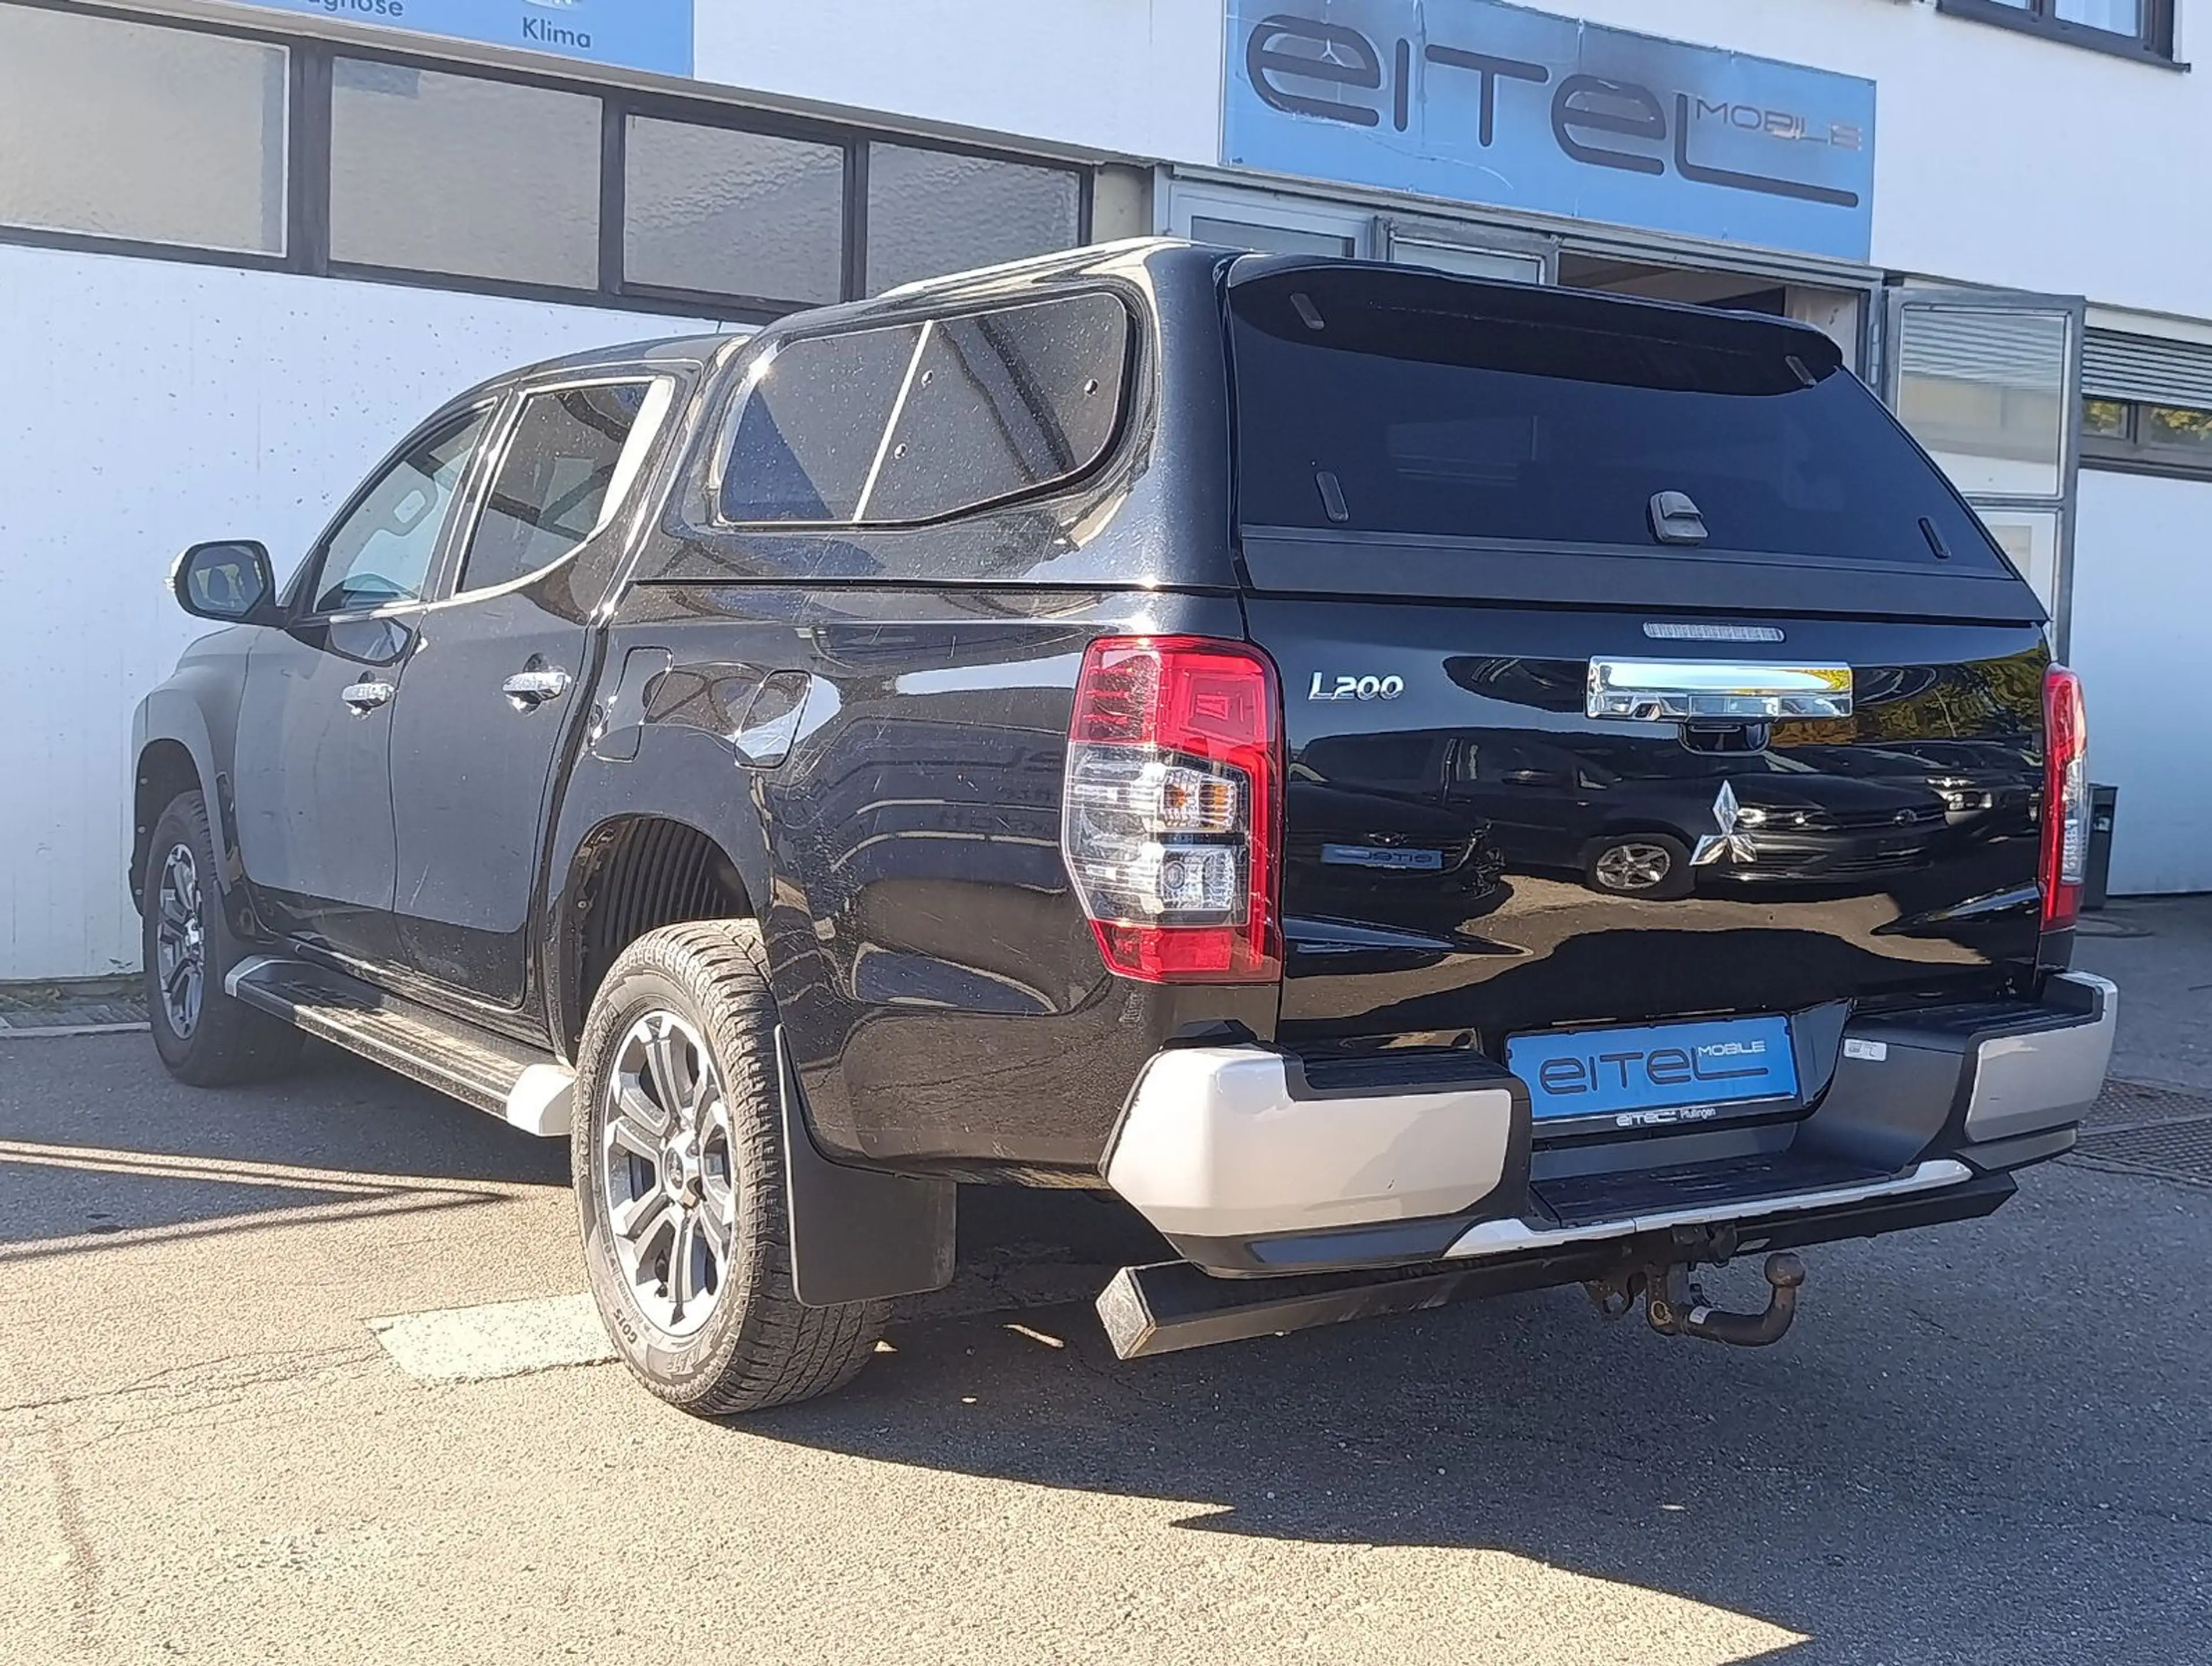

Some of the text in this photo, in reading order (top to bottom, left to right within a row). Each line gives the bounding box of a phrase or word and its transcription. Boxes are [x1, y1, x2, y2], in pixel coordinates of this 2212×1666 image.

[308, 0, 403, 16] gnose
[522, 17, 591, 48] Klima
[1696, 97, 1861, 150] MOBILE
[1308, 671, 1405, 701] L200
[1698, 1040, 1766, 1058] MOBILE
[613, 1308, 638, 1345] G015
